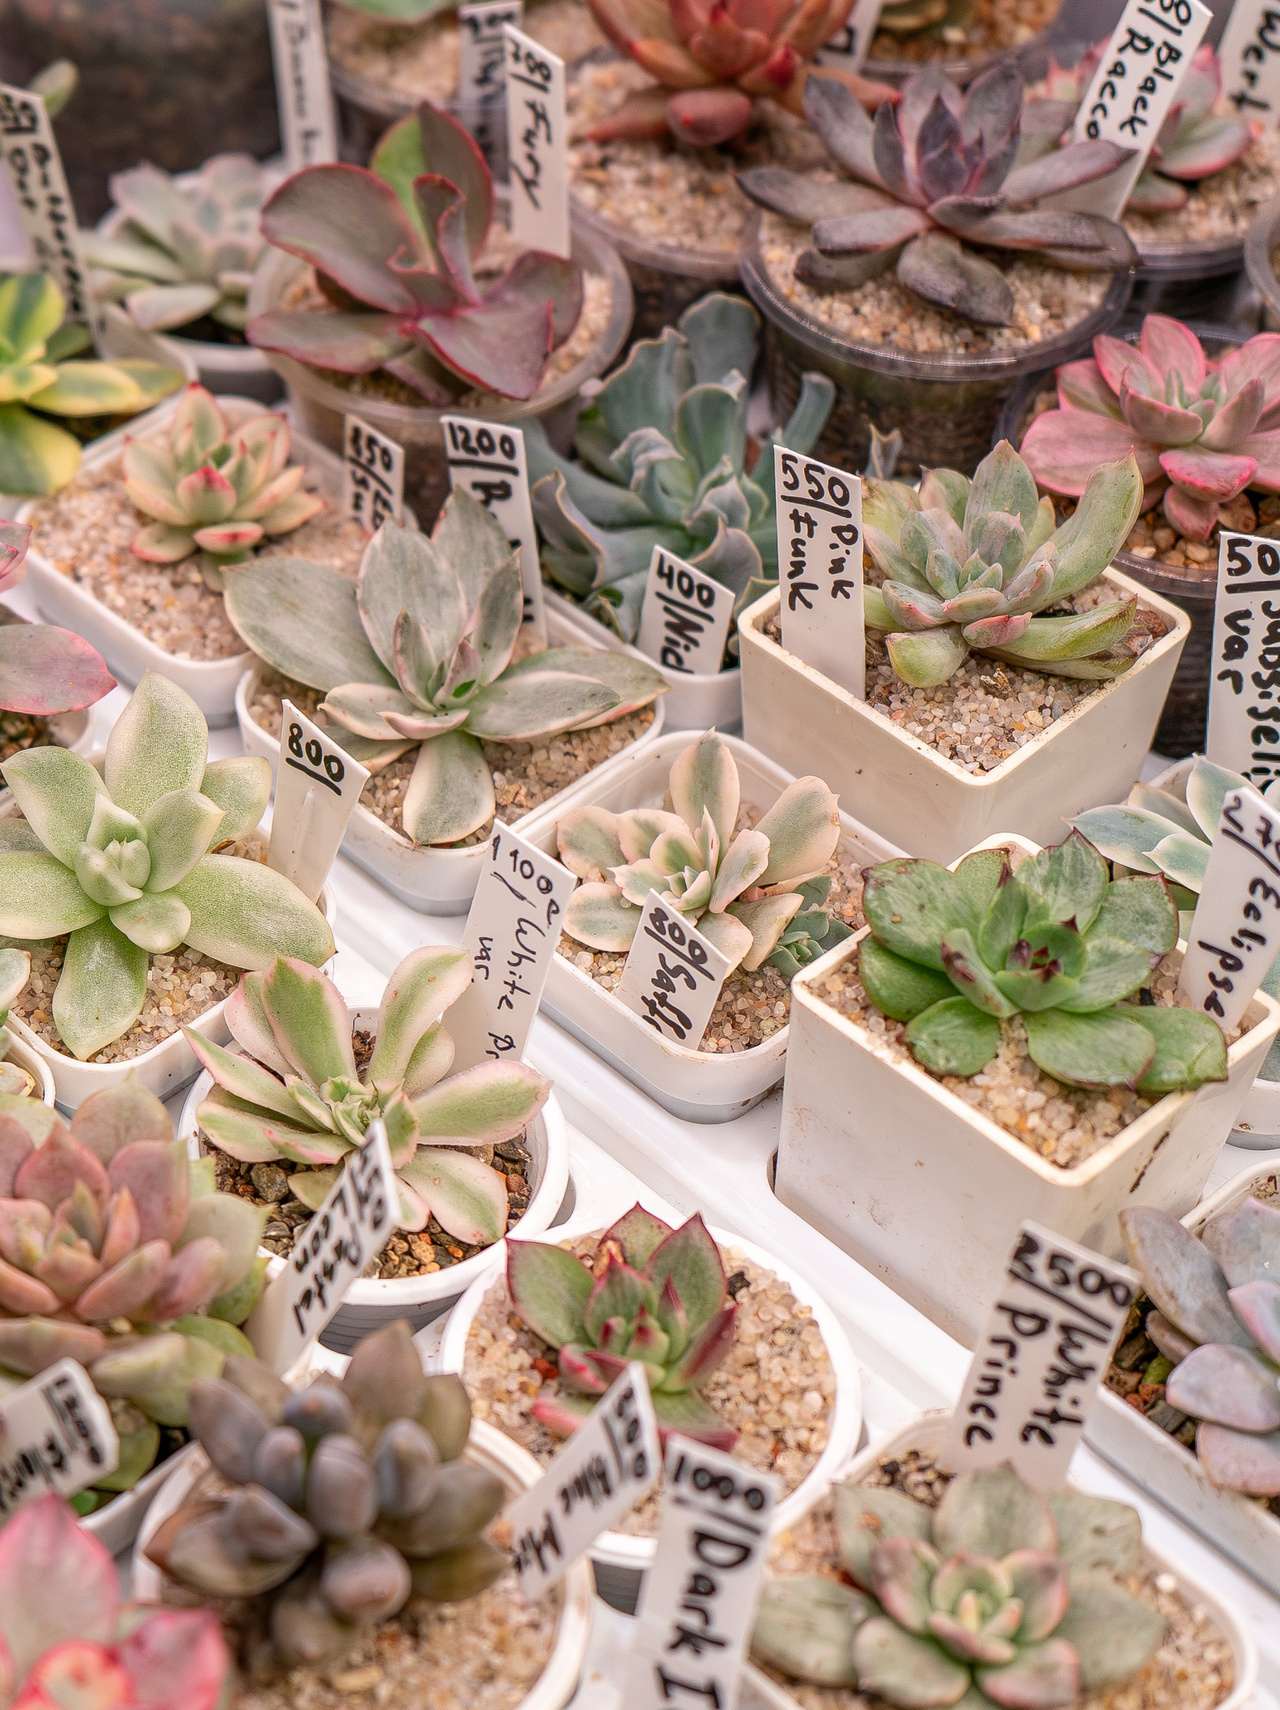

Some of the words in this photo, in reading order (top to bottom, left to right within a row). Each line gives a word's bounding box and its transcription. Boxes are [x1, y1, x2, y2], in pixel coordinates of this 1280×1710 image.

[1086, 27, 1154, 140] Racco
[1119, 40, 1183, 137] Black
[449, 421, 516, 461] 1200
[781, 453, 851, 507] 550
[657, 553, 715, 609] 400
[786, 508, 820, 612] Funk
[828, 523, 859, 600] Pink
[1217, 608, 1253, 696] var
[288, 722, 345, 783] 800
[497, 916, 546, 1010] White
[649, 907, 708, 965] 800
[1011, 1232, 1132, 1307] 2500
[963, 1302, 1050, 1447] Prince
[1020, 1322, 1108, 1446] White
[669, 1528, 752, 1655] Dark
